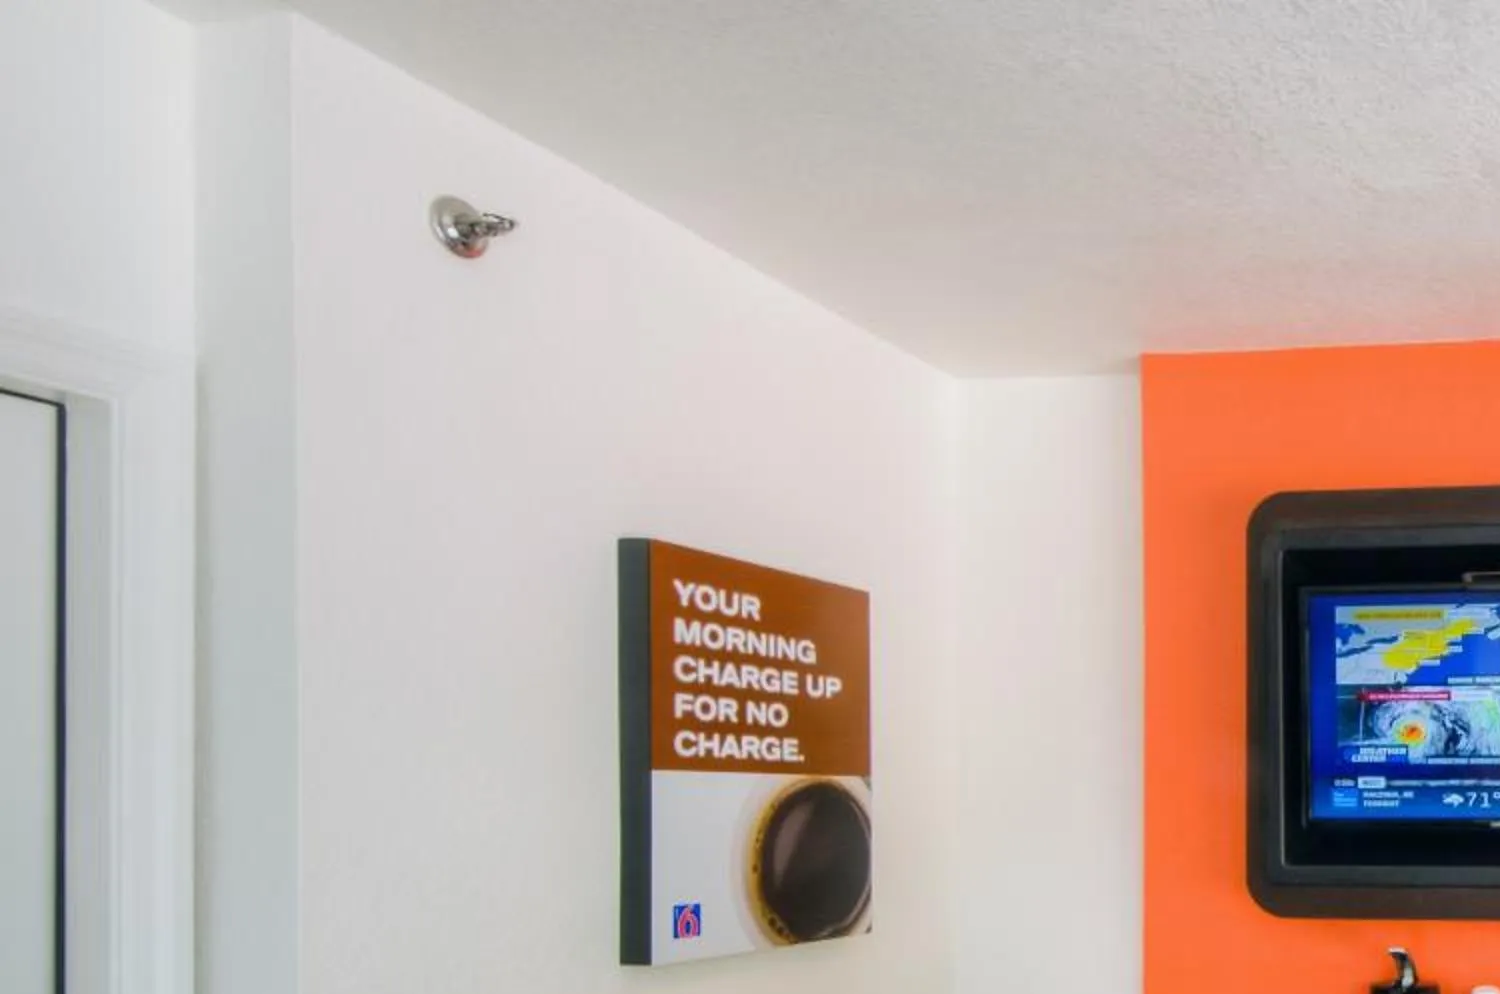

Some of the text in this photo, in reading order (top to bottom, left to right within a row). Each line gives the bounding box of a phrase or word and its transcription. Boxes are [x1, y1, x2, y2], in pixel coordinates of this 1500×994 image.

[673, 579, 761, 620] YOUR
[673, 617, 817, 662] MORNING
[673, 655, 843, 700] CHARGE UP
[673, 693, 789, 729] FOR NO
[673, 731, 805, 763] CHARGE.
